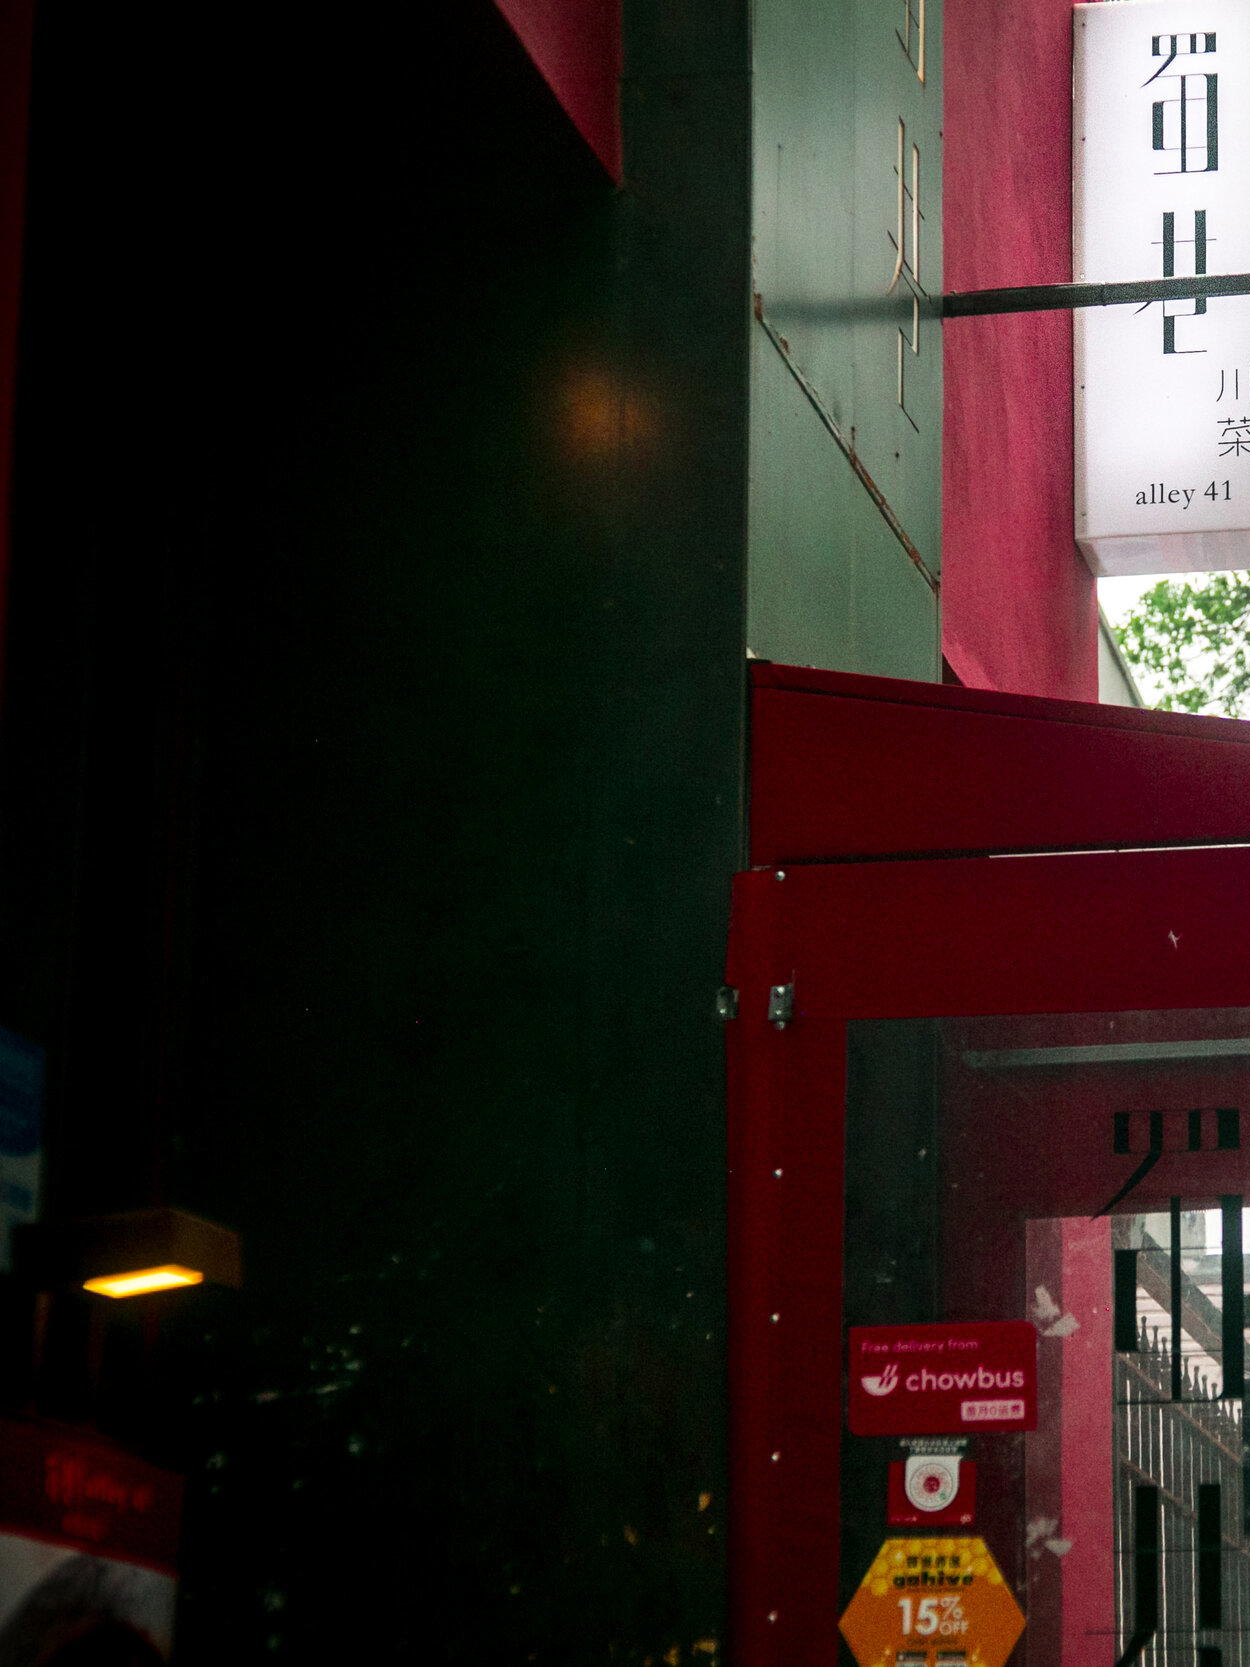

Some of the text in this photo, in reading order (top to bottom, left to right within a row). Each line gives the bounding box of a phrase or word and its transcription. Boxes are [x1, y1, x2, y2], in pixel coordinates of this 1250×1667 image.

[1134, 480, 1233, 509] alley 41
[861, 1341, 889, 1355] Free
[947, 1338, 979, 1351] from
[904, 1366, 1025, 1392] chowbus
